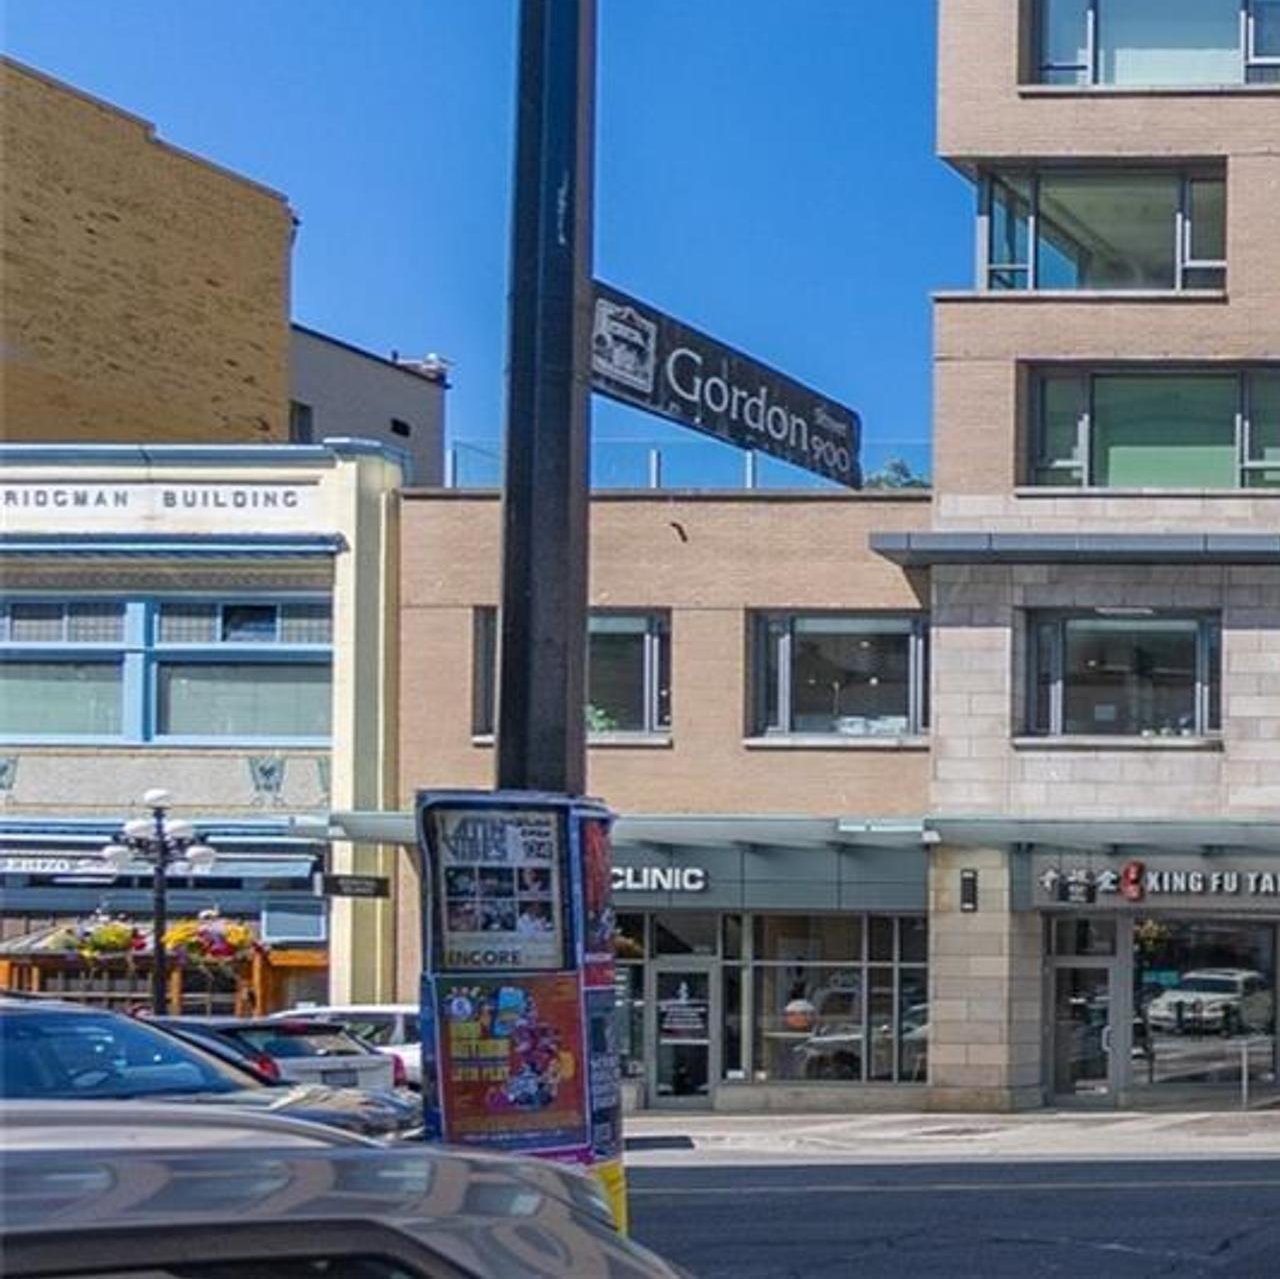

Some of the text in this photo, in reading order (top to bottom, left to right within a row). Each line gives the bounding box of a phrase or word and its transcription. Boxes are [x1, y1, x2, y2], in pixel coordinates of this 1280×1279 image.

[667, 348, 809, 451] Gordon
[811, 435, 851, 472] 900
[163, 490, 299, 508] BUILDING
[611, 867, 705, 891] CLINIC
[1211, 872, 1238, 893] FU
